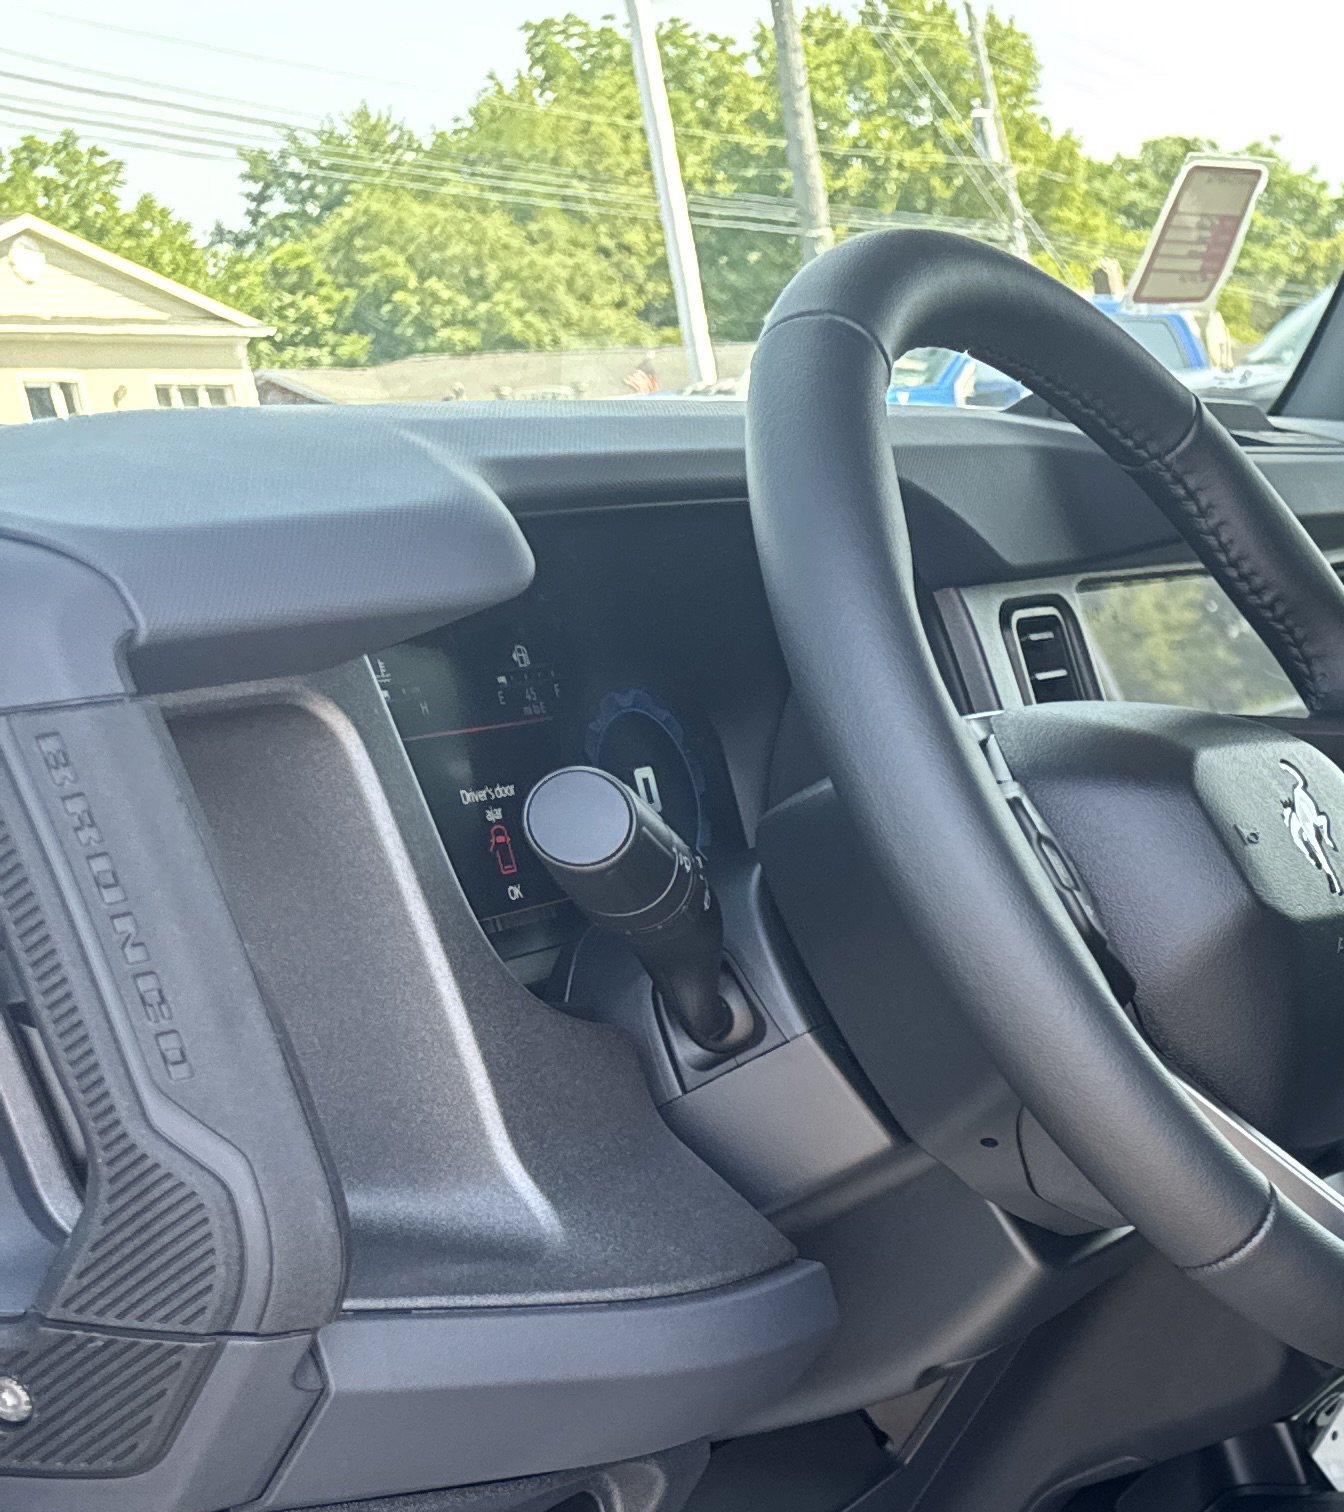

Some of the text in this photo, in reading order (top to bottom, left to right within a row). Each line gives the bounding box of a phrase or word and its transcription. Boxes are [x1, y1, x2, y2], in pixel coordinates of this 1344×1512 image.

[460, 783, 515, 805] Driver's door
[486, 806, 503, 823] ajar
[507, 884, 523, 901] OK
[35, 731, 195, 1082] BRONCO
